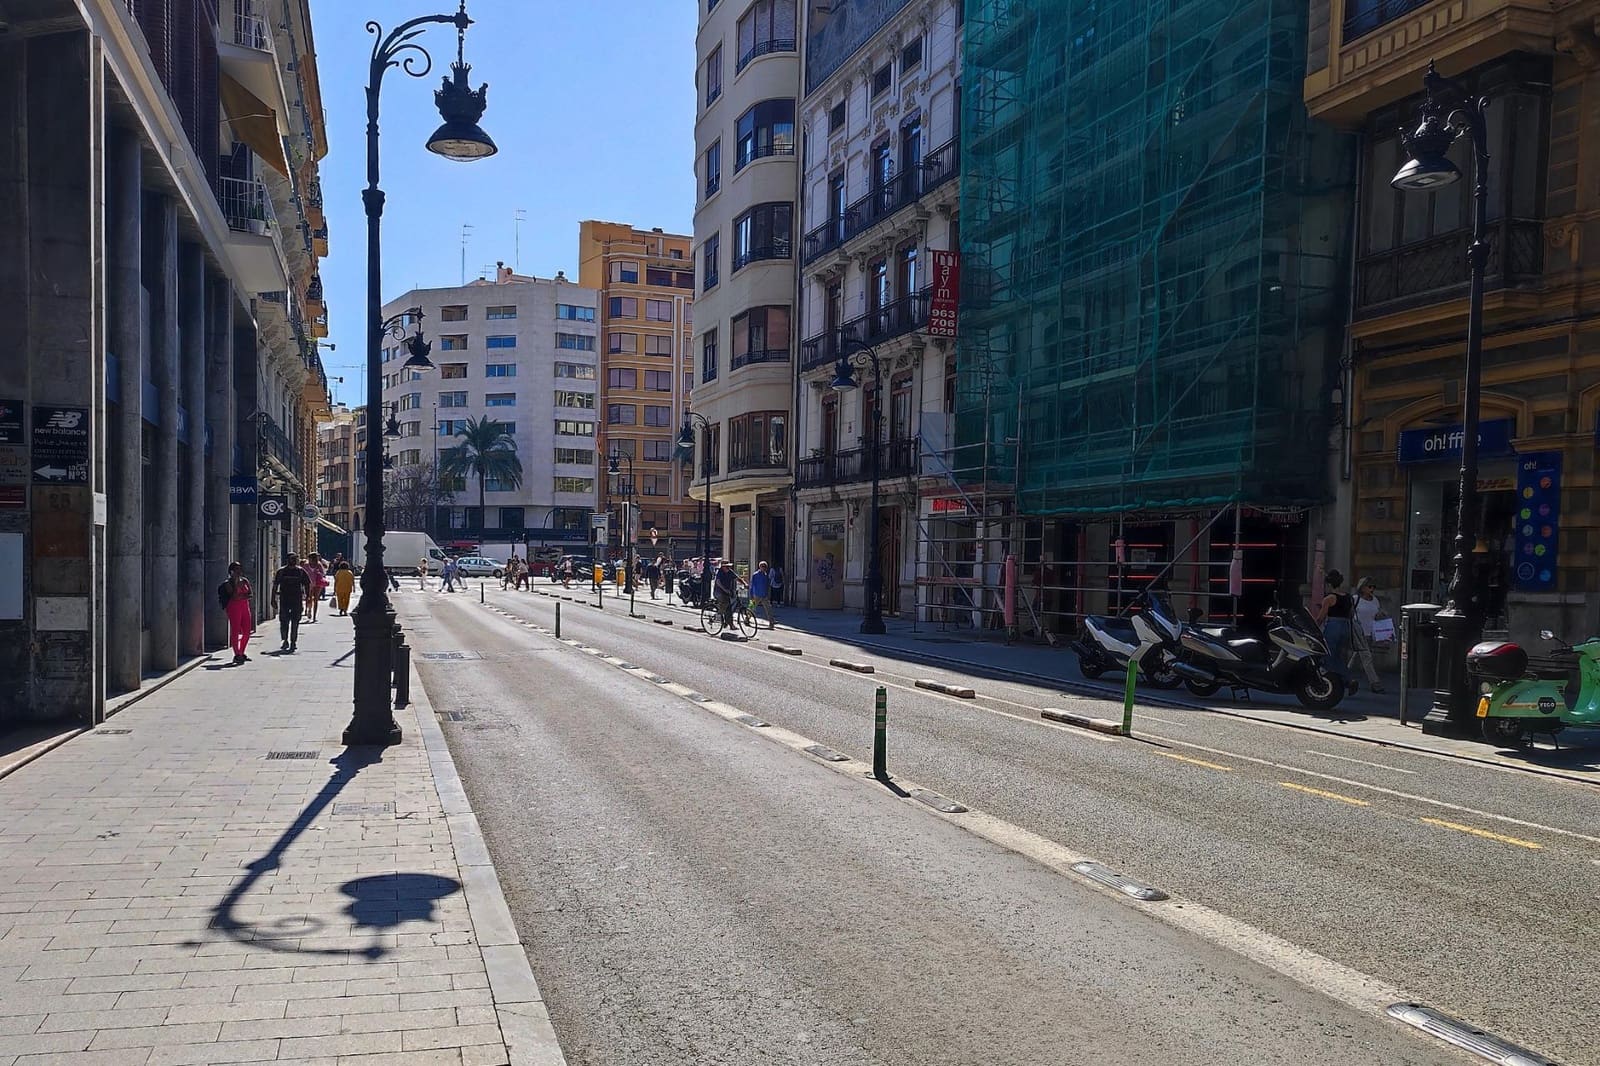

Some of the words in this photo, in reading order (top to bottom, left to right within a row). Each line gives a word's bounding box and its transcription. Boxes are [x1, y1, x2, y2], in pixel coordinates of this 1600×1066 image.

[932, 309, 955, 318] 963
[931, 318, 955, 328] 706
[930, 327, 955, 336] 028
[1523, 460, 1537, 471] oh!
